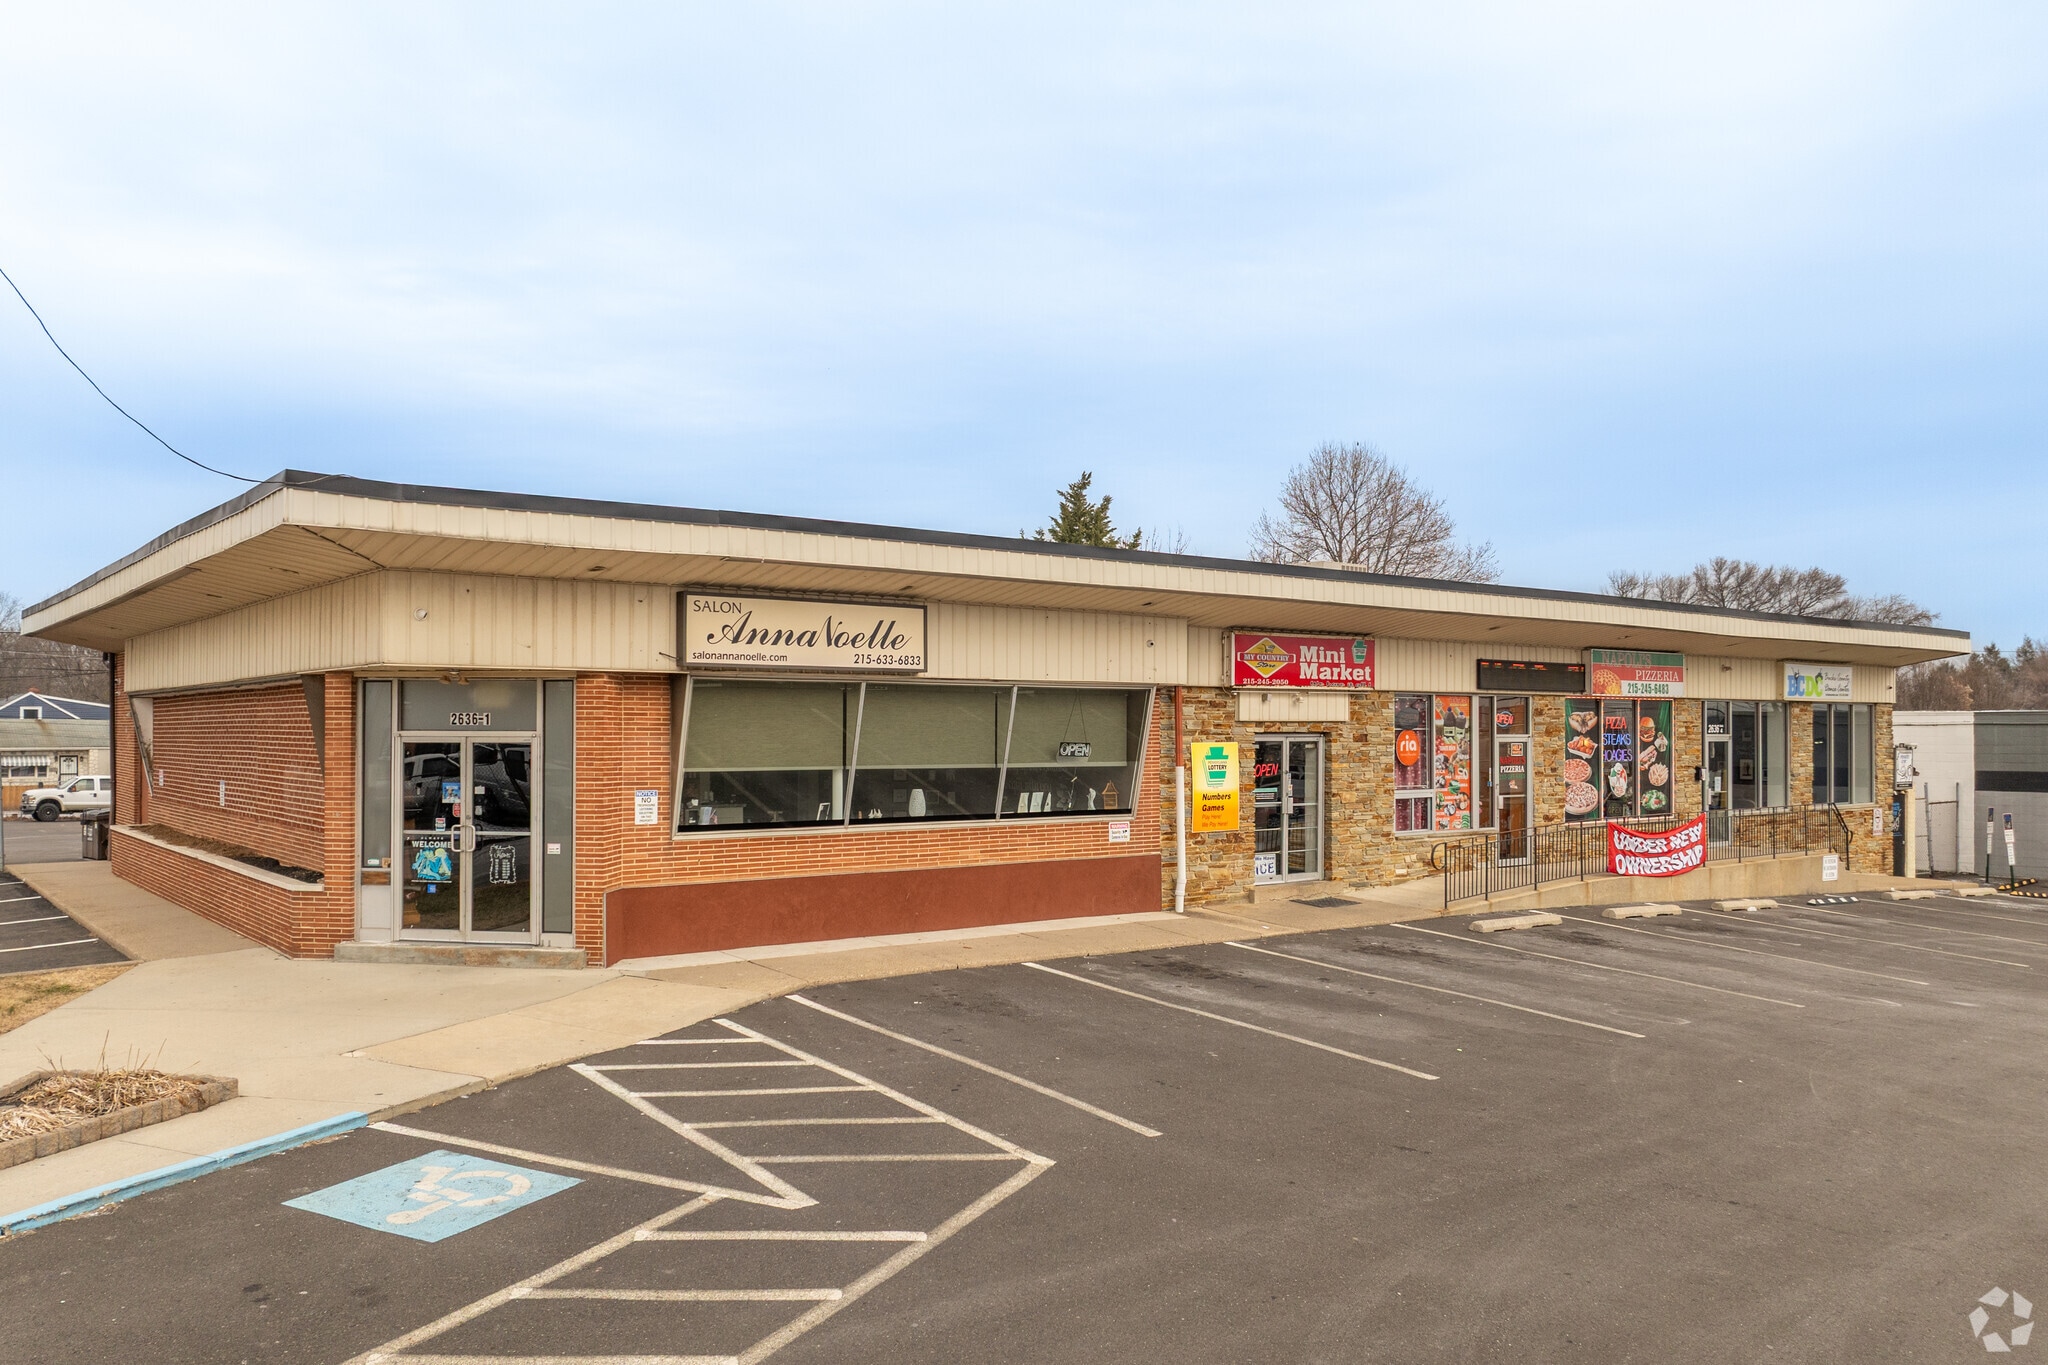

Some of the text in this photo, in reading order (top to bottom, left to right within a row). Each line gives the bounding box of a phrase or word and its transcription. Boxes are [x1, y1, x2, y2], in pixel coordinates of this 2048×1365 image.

[693, 600, 742, 614] SALON
[692, 651, 788, 662] salonannanoelle.com
[854, 653, 921, 666] 215-633-6833
[1256, 654, 1290, 662] COUNTRY
[1299, 646, 1346, 664] Mini
[1601, 651, 1652, 668] NAPOLI'S
[1299, 662, 1372, 681] Market
[1635, 669, 1679, 682] PIZZERIA
[1627, 683, 1669, 695] 215-245-6483
[1787, 674, 1823, 697] BCDC
[451, 713, 490, 725] 2636-1
[1496, 713, 1514, 725] OPEN
[1605, 716, 1627, 729] PIZZA
[1400, 734, 1417, 751] ria
[1602, 733, 1631, 746] STEAKS
[1060, 743, 1090, 757] OPEN
[1603, 749, 1633, 762] HOAGIES
[1255, 763, 1279, 777] OPEN
[1500, 765, 1525, 773] PIZZERIA
[1202, 793, 1231, 801] Numbers
[1202, 804, 1225, 812] Games
[1613, 822, 1703, 854] UNDER NEW
[412, 841, 451, 849] WELCOME
[1615, 844, 1704, 875] OWNERSHIP
[1256, 862, 1275, 875] ICE
